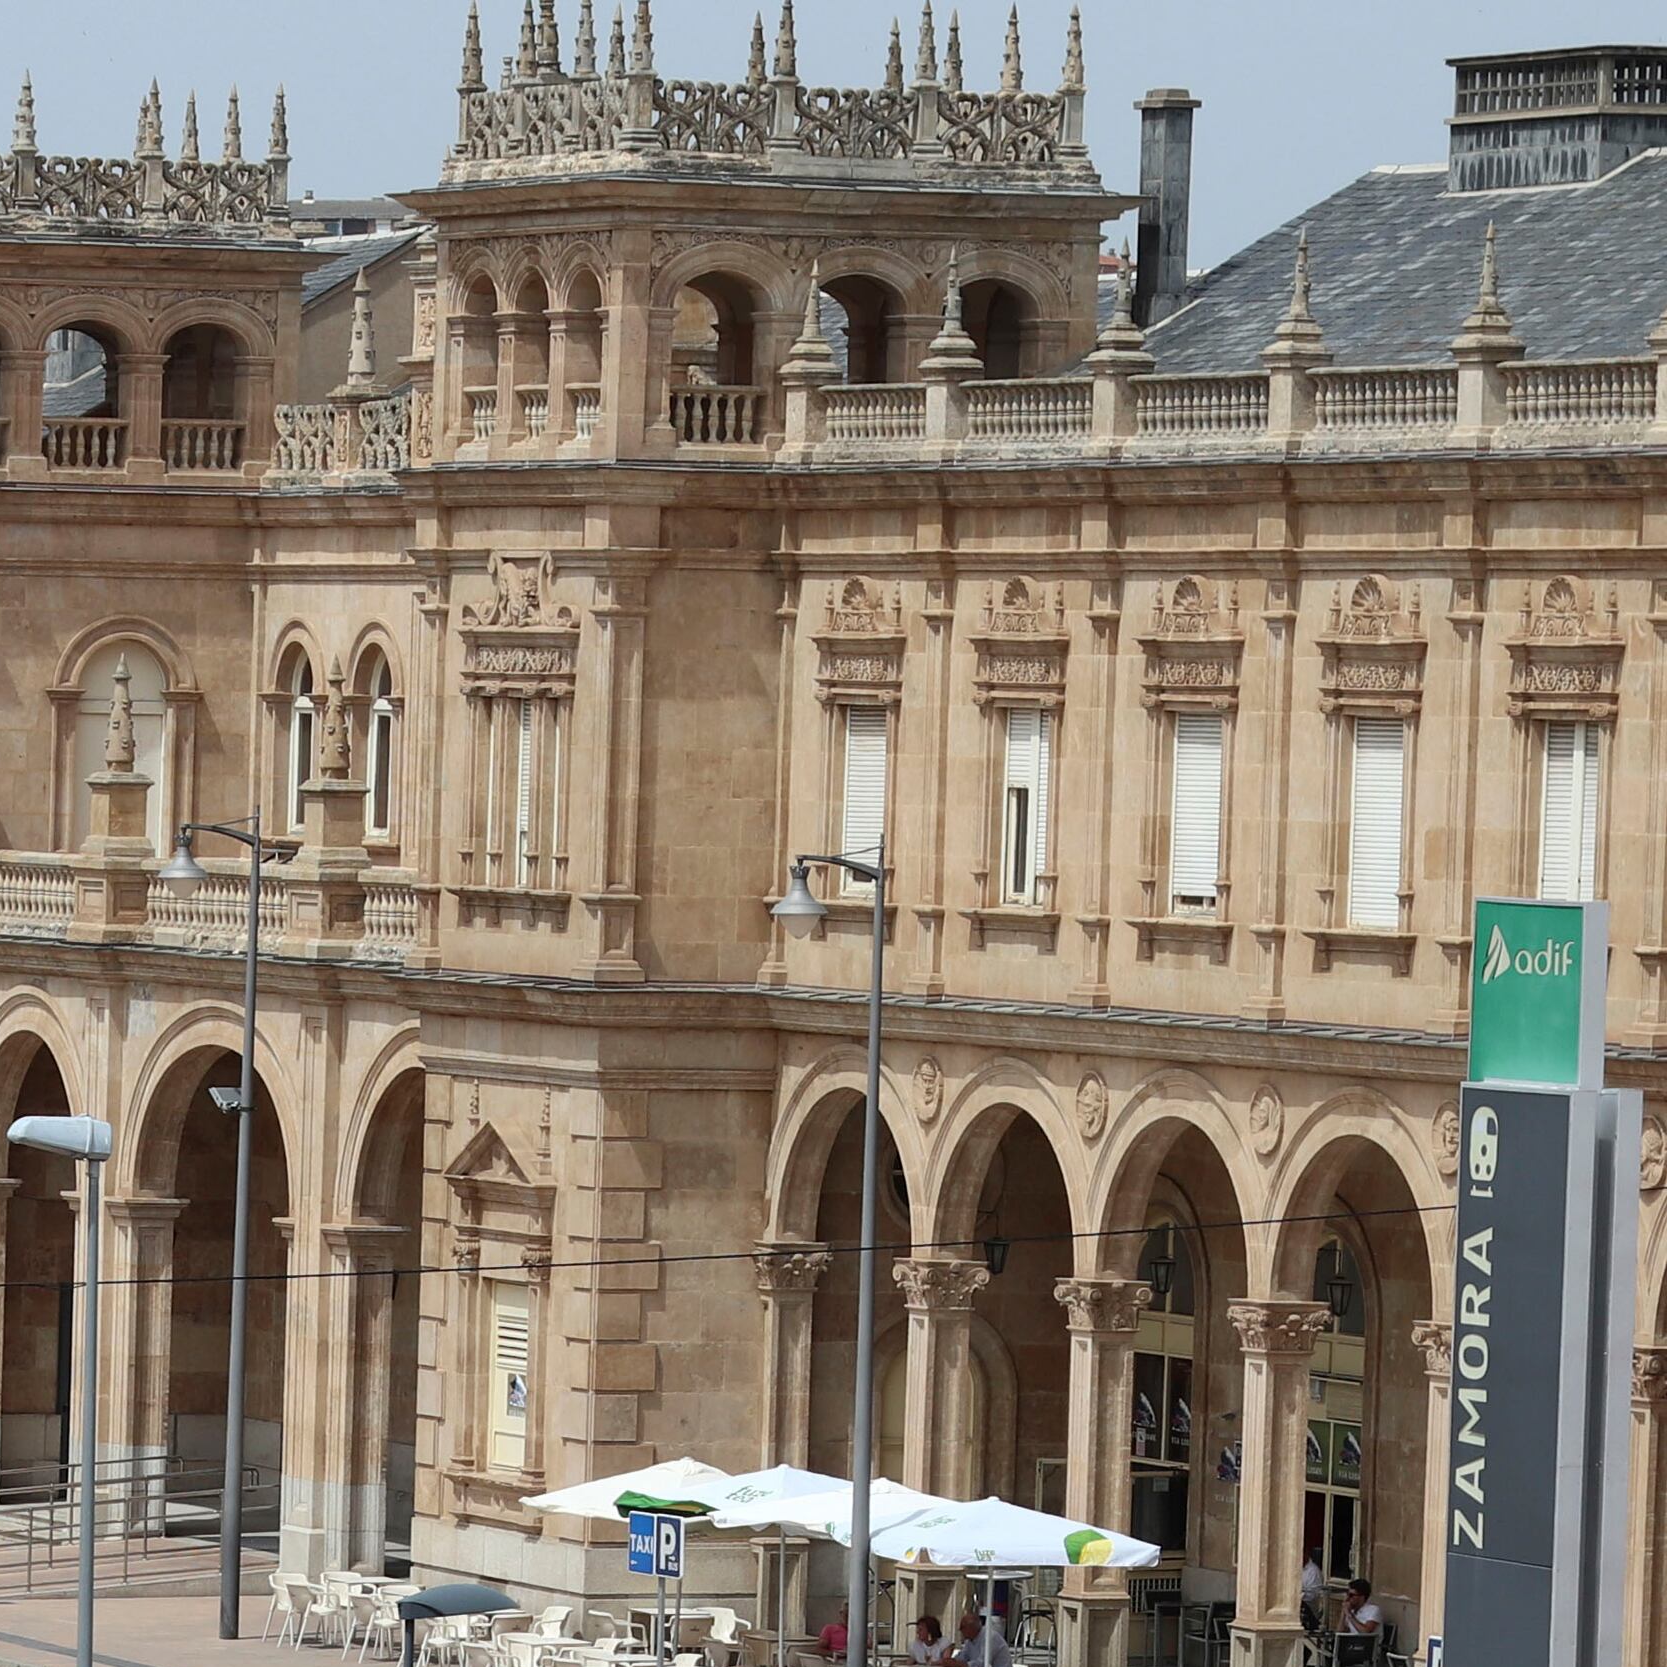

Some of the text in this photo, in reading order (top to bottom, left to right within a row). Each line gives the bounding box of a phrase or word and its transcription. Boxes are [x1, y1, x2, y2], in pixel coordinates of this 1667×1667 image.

[1514, 938, 1575, 976] adif
[1453, 1226, 1493, 1550] ZAMORA
[630, 1533, 654, 1555] TAXI
[659, 1522, 677, 1571] P
